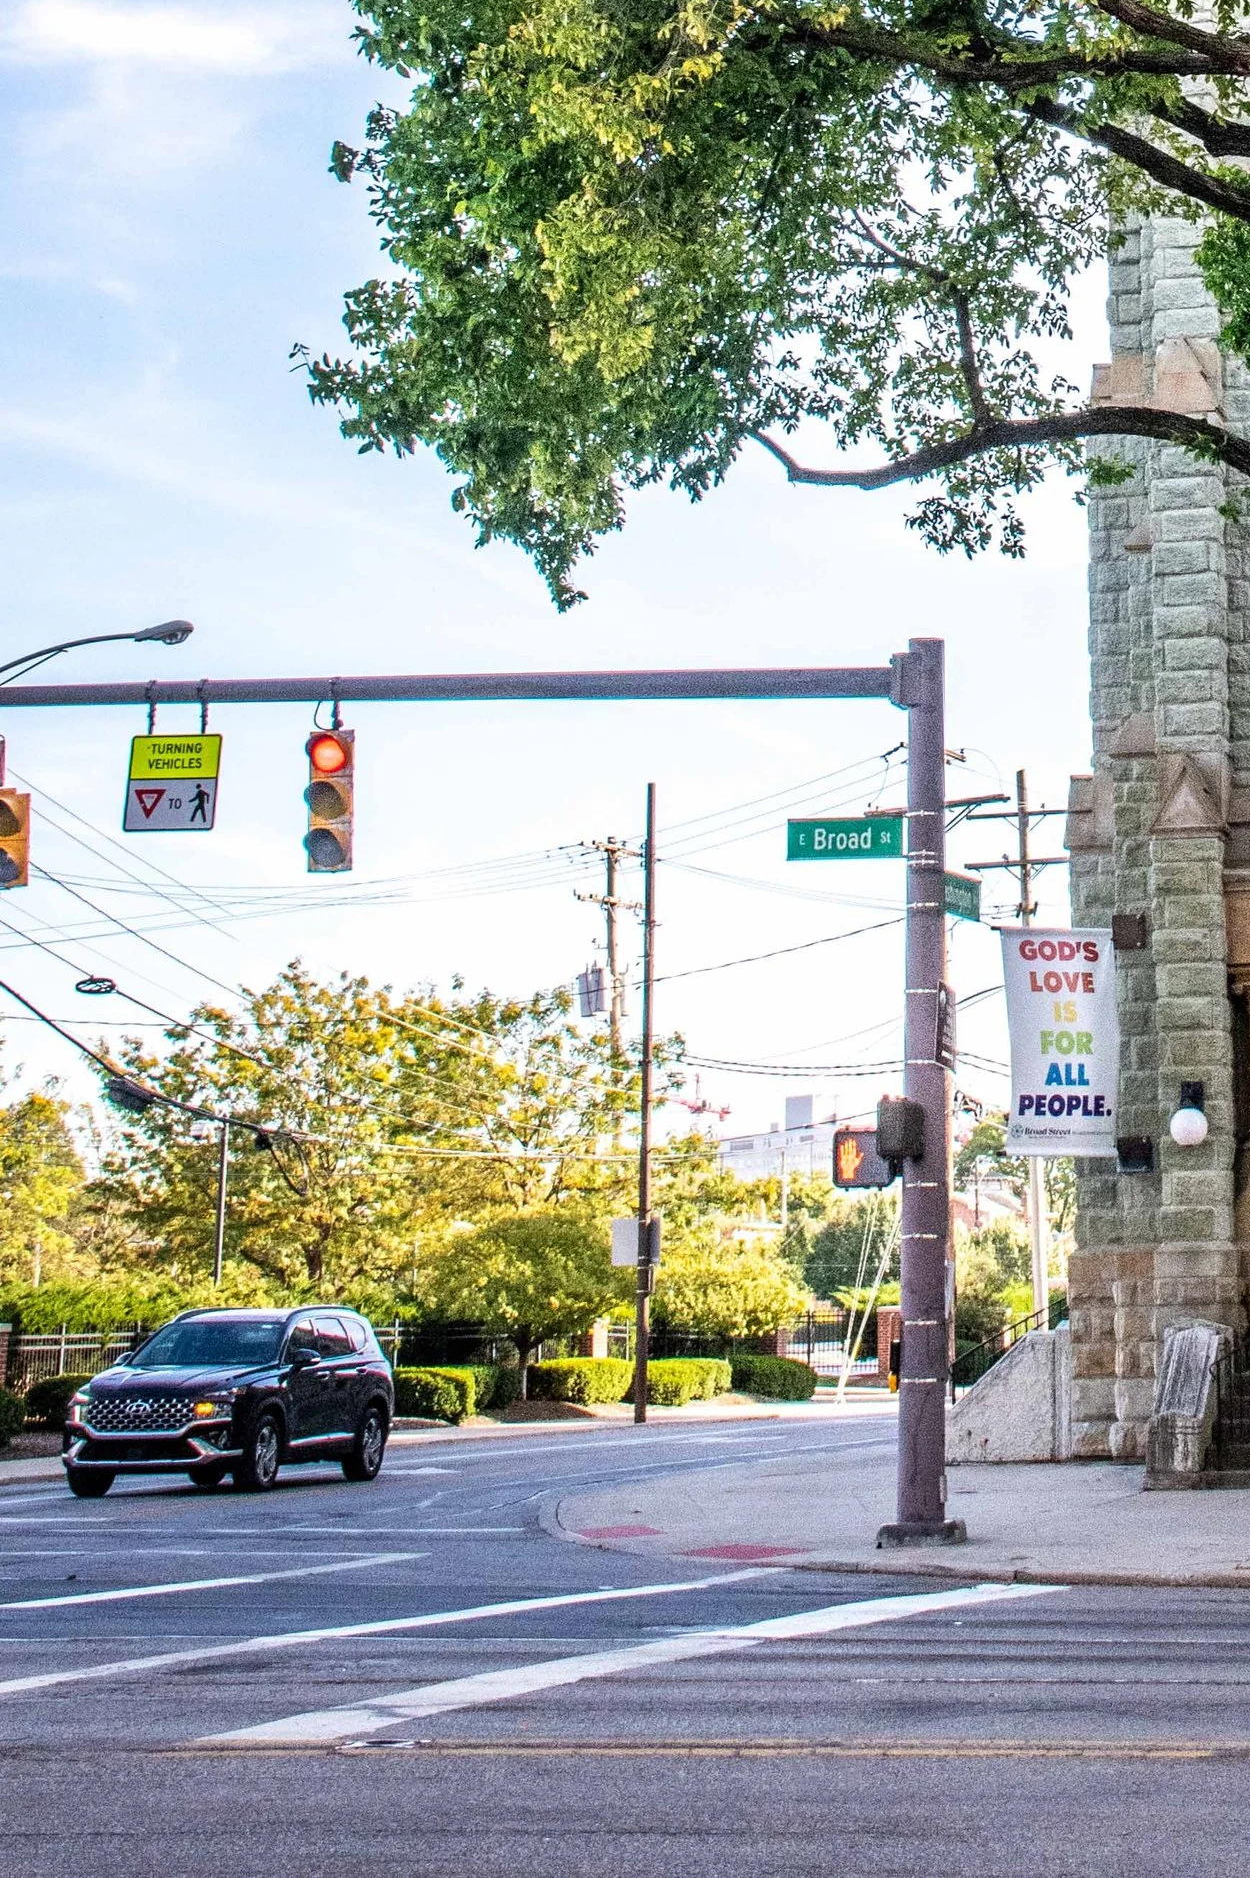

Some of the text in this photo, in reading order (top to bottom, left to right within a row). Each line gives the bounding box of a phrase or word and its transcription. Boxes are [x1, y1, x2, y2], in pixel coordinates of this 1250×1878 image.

[151, 743, 202, 755] TURNING
[148, 757, 202, 770] VEHICLES
[169, 798, 182, 810] TO
[799, 826, 891, 850] E Broad St
[1019, 940, 1099, 962] GOD'S
[1029, 971, 1095, 993] LOVE
[1053, 1001, 1078, 1023] IS
[1040, 1030, 1094, 1055] FOR
[1044, 1062, 1090, 1086] ALL
[1018, 1094, 1112, 1117] PEOPLE.
[1024, 1127, 1047, 1136] Broad
[1048, 1127, 1071, 1136] Street
